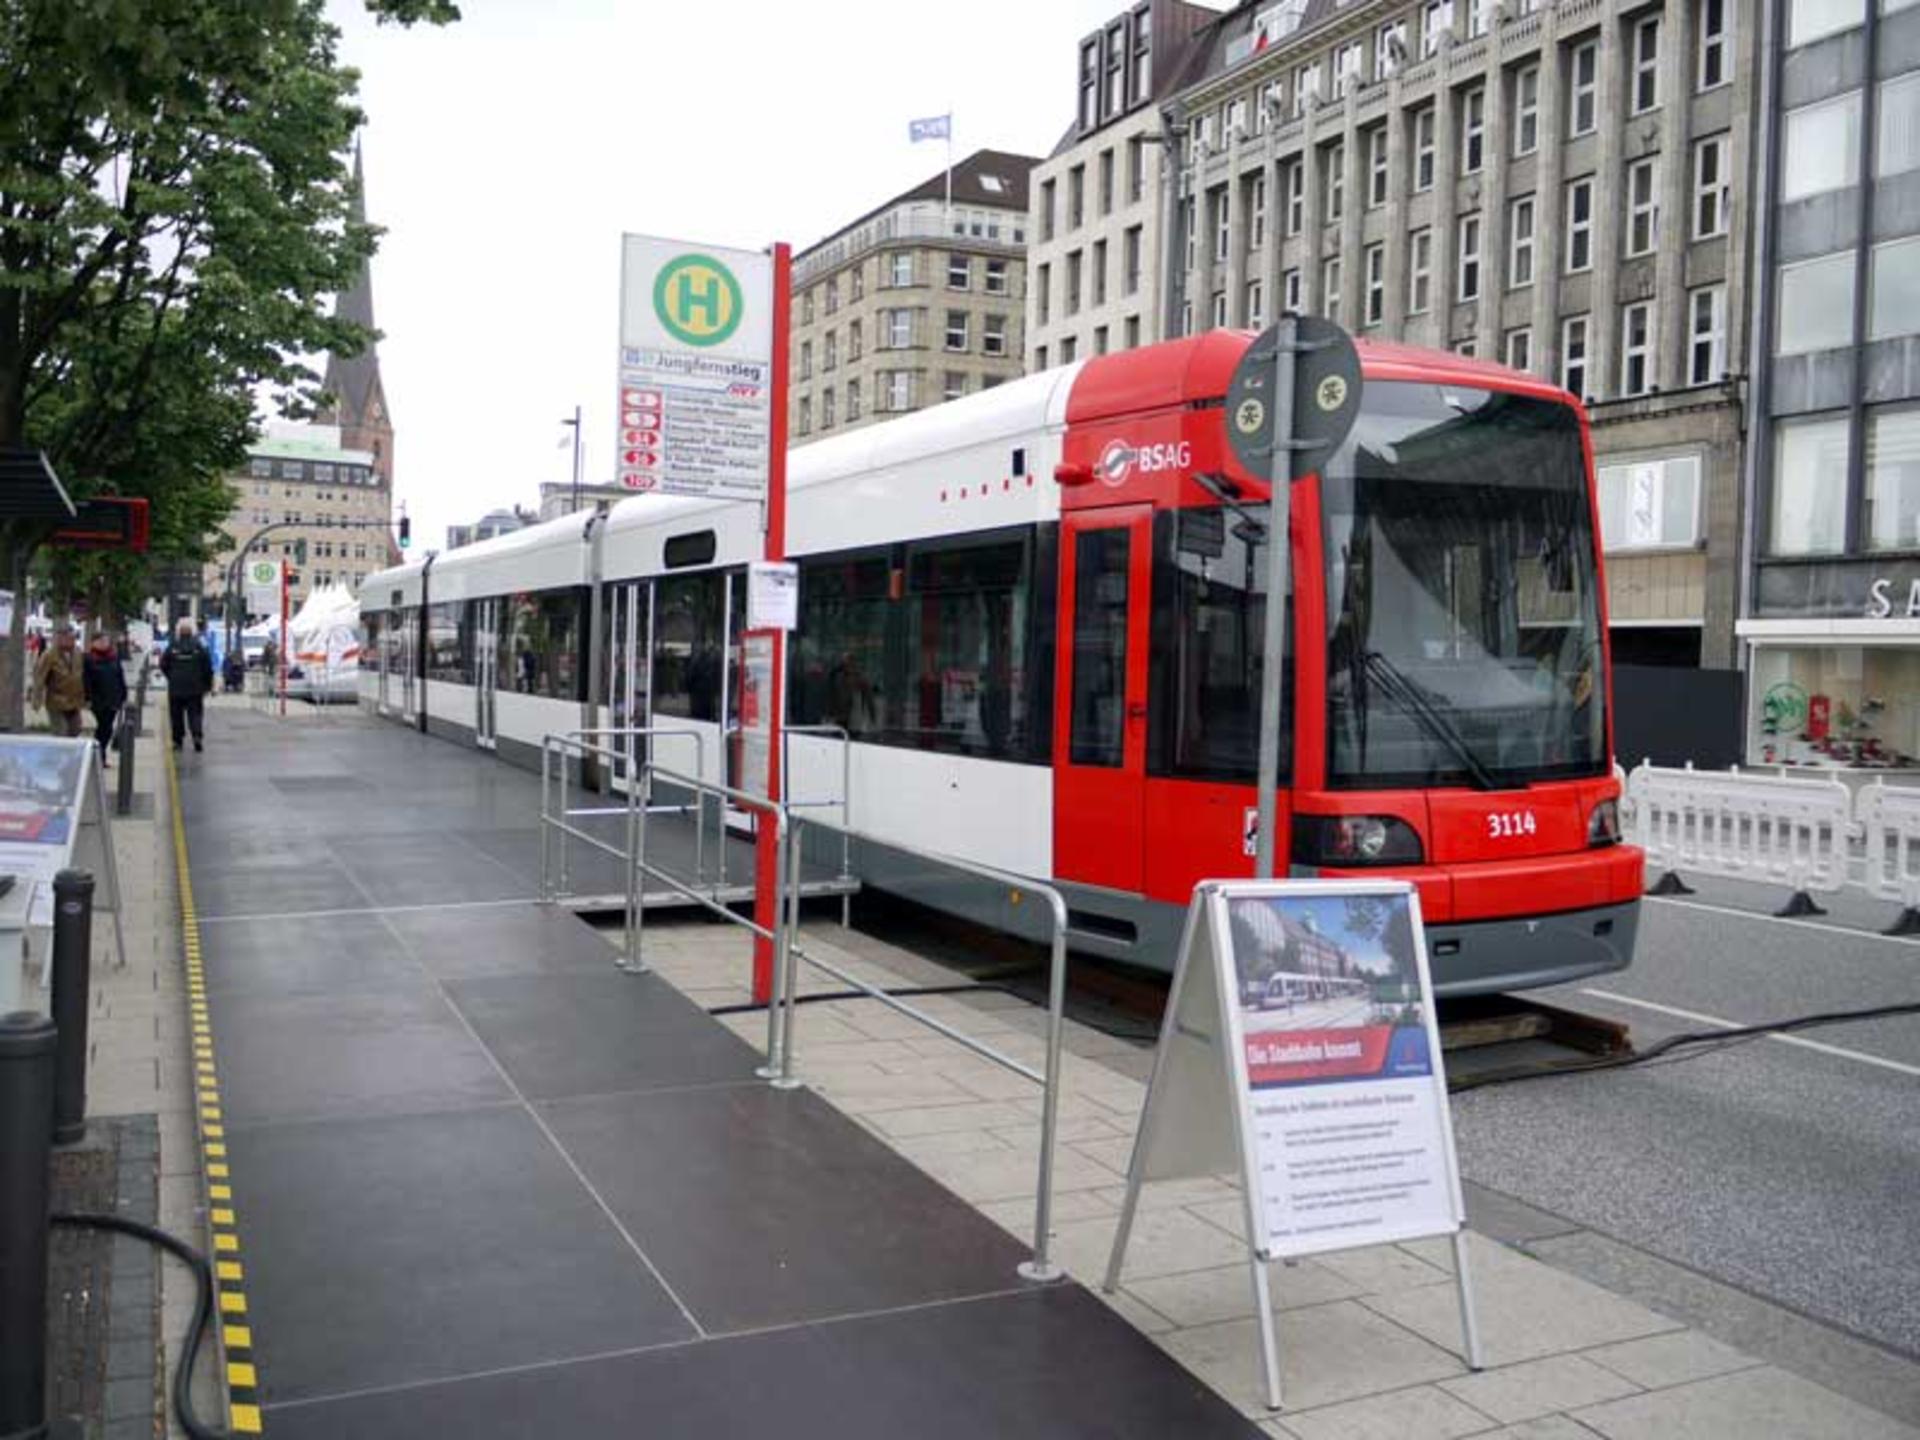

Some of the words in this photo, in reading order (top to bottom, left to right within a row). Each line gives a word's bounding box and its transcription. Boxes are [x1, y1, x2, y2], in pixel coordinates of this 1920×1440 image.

[678, 272, 719, 328] H
[656, 353, 761, 381] Jungfernstieg
[1138, 441, 1191, 472] BSAG
[1486, 810, 1536, 838] 3114
